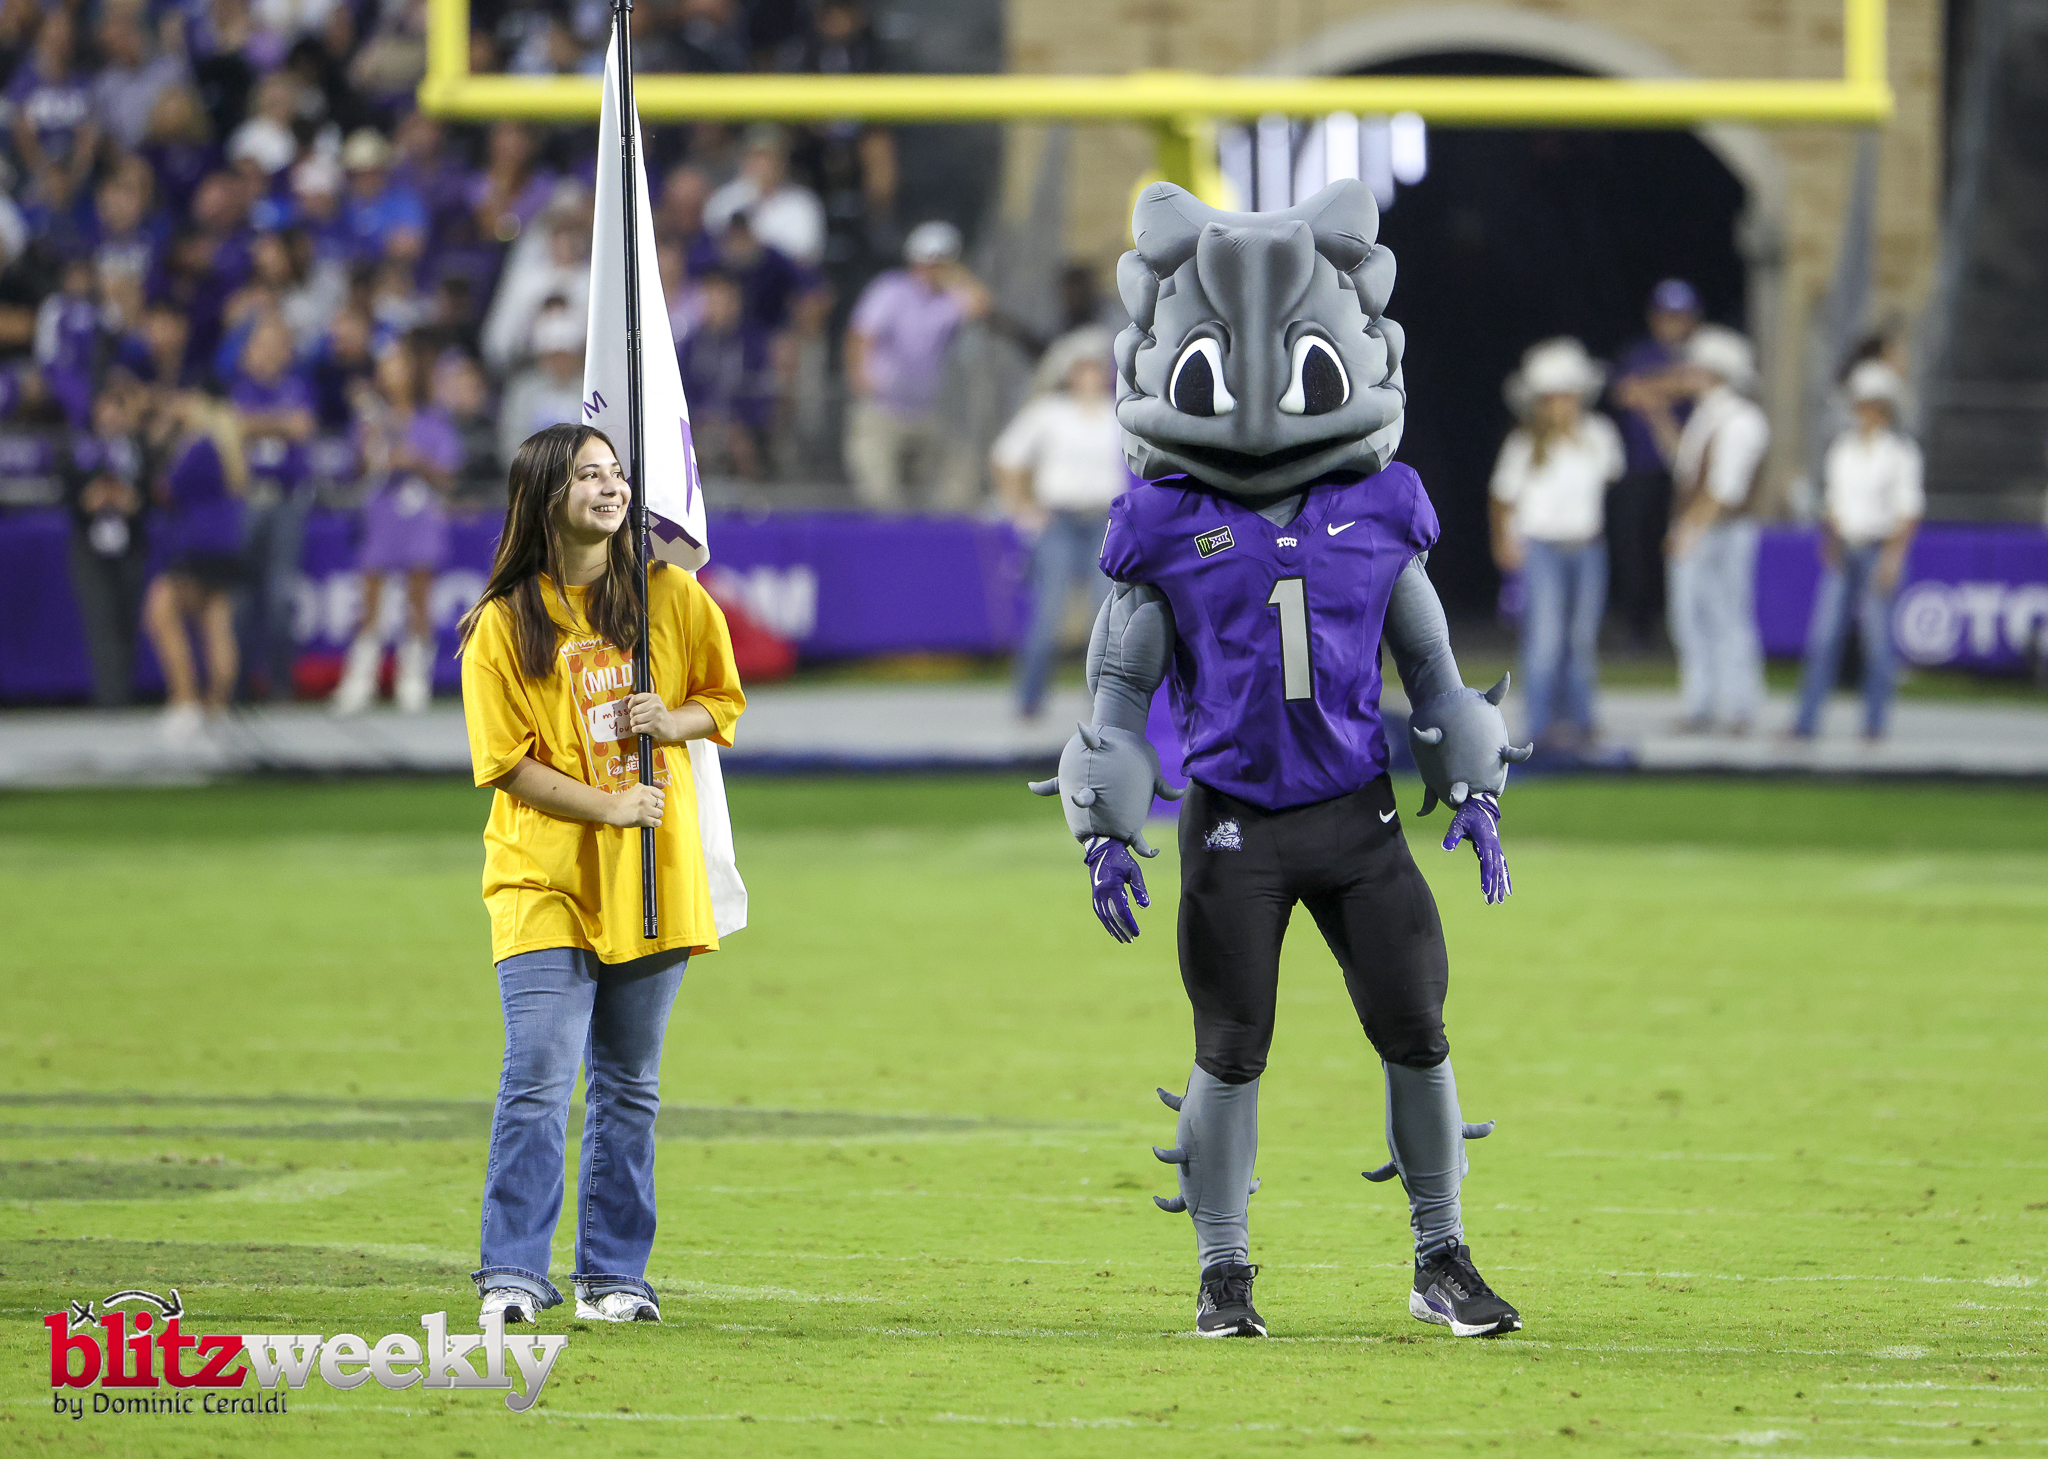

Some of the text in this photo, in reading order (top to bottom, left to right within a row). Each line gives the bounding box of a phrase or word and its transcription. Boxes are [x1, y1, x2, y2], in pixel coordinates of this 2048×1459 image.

[1276, 536, 1298, 548] TCU
[1264, 574, 1316, 704] 1
[582, 659, 635, 700] (MILD
[602, 708, 630, 720] miss
[623, 752, 640, 763] TAC
[625, 761, 640, 772] BE
